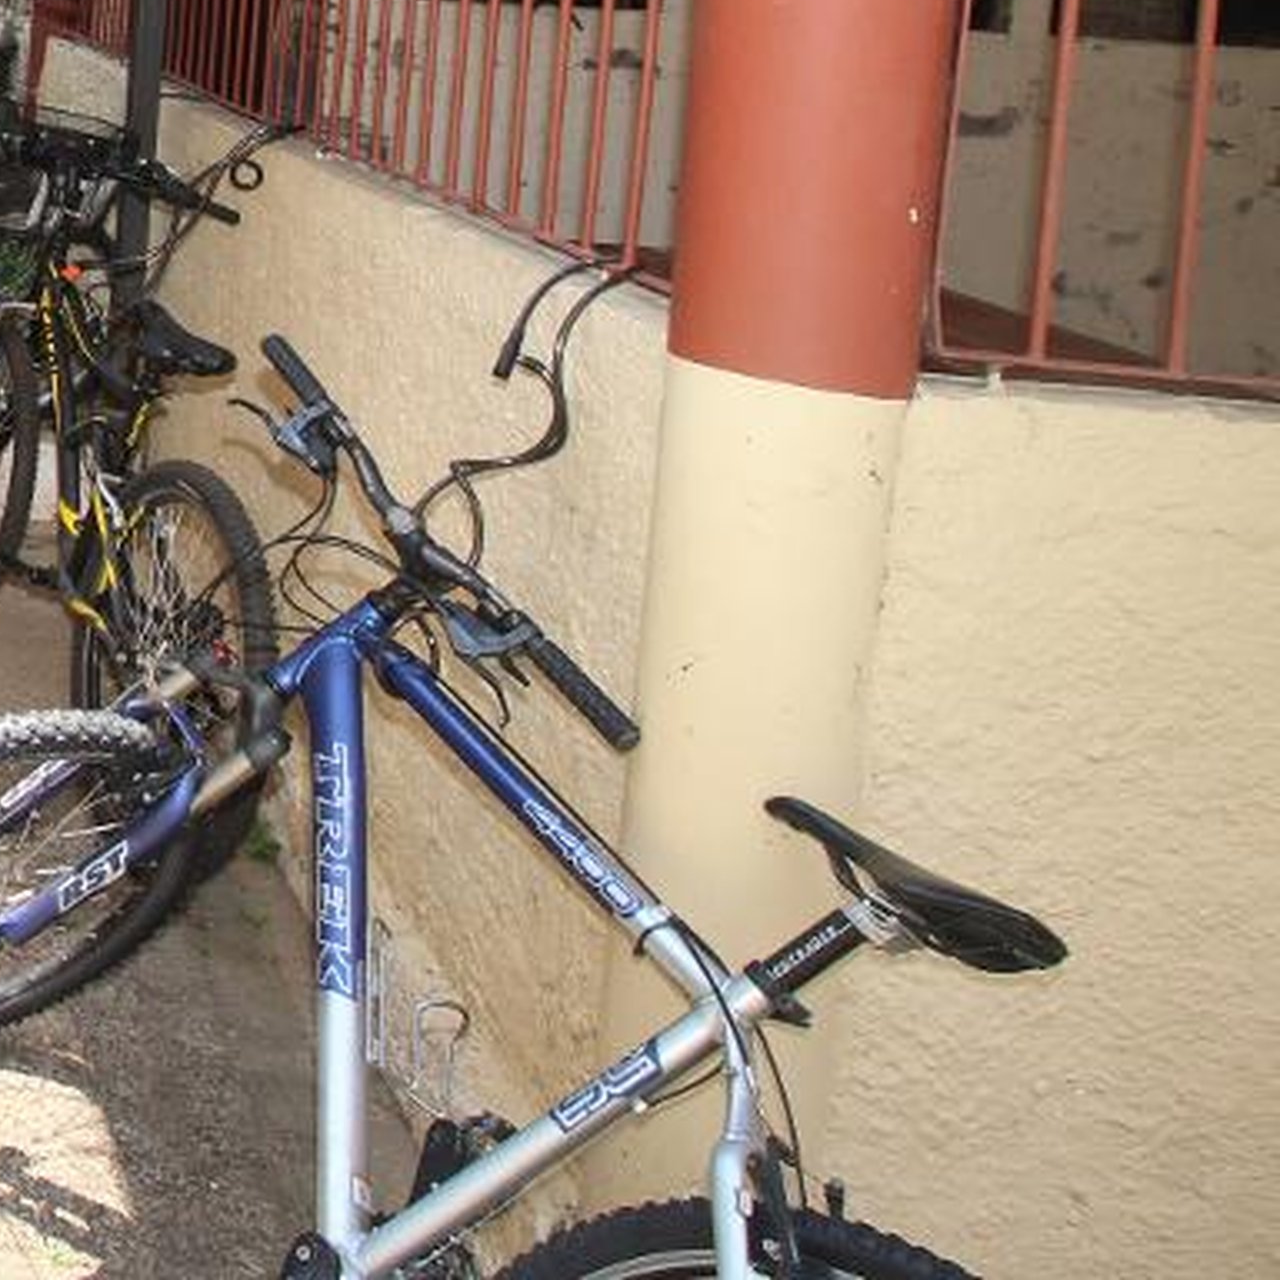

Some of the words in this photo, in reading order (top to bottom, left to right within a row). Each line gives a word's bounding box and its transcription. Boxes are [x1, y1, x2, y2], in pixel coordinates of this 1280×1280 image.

[57, 839, 129, 912] RST
[313, 741, 354, 995] TREK
[522, 799, 639, 916] 4400
